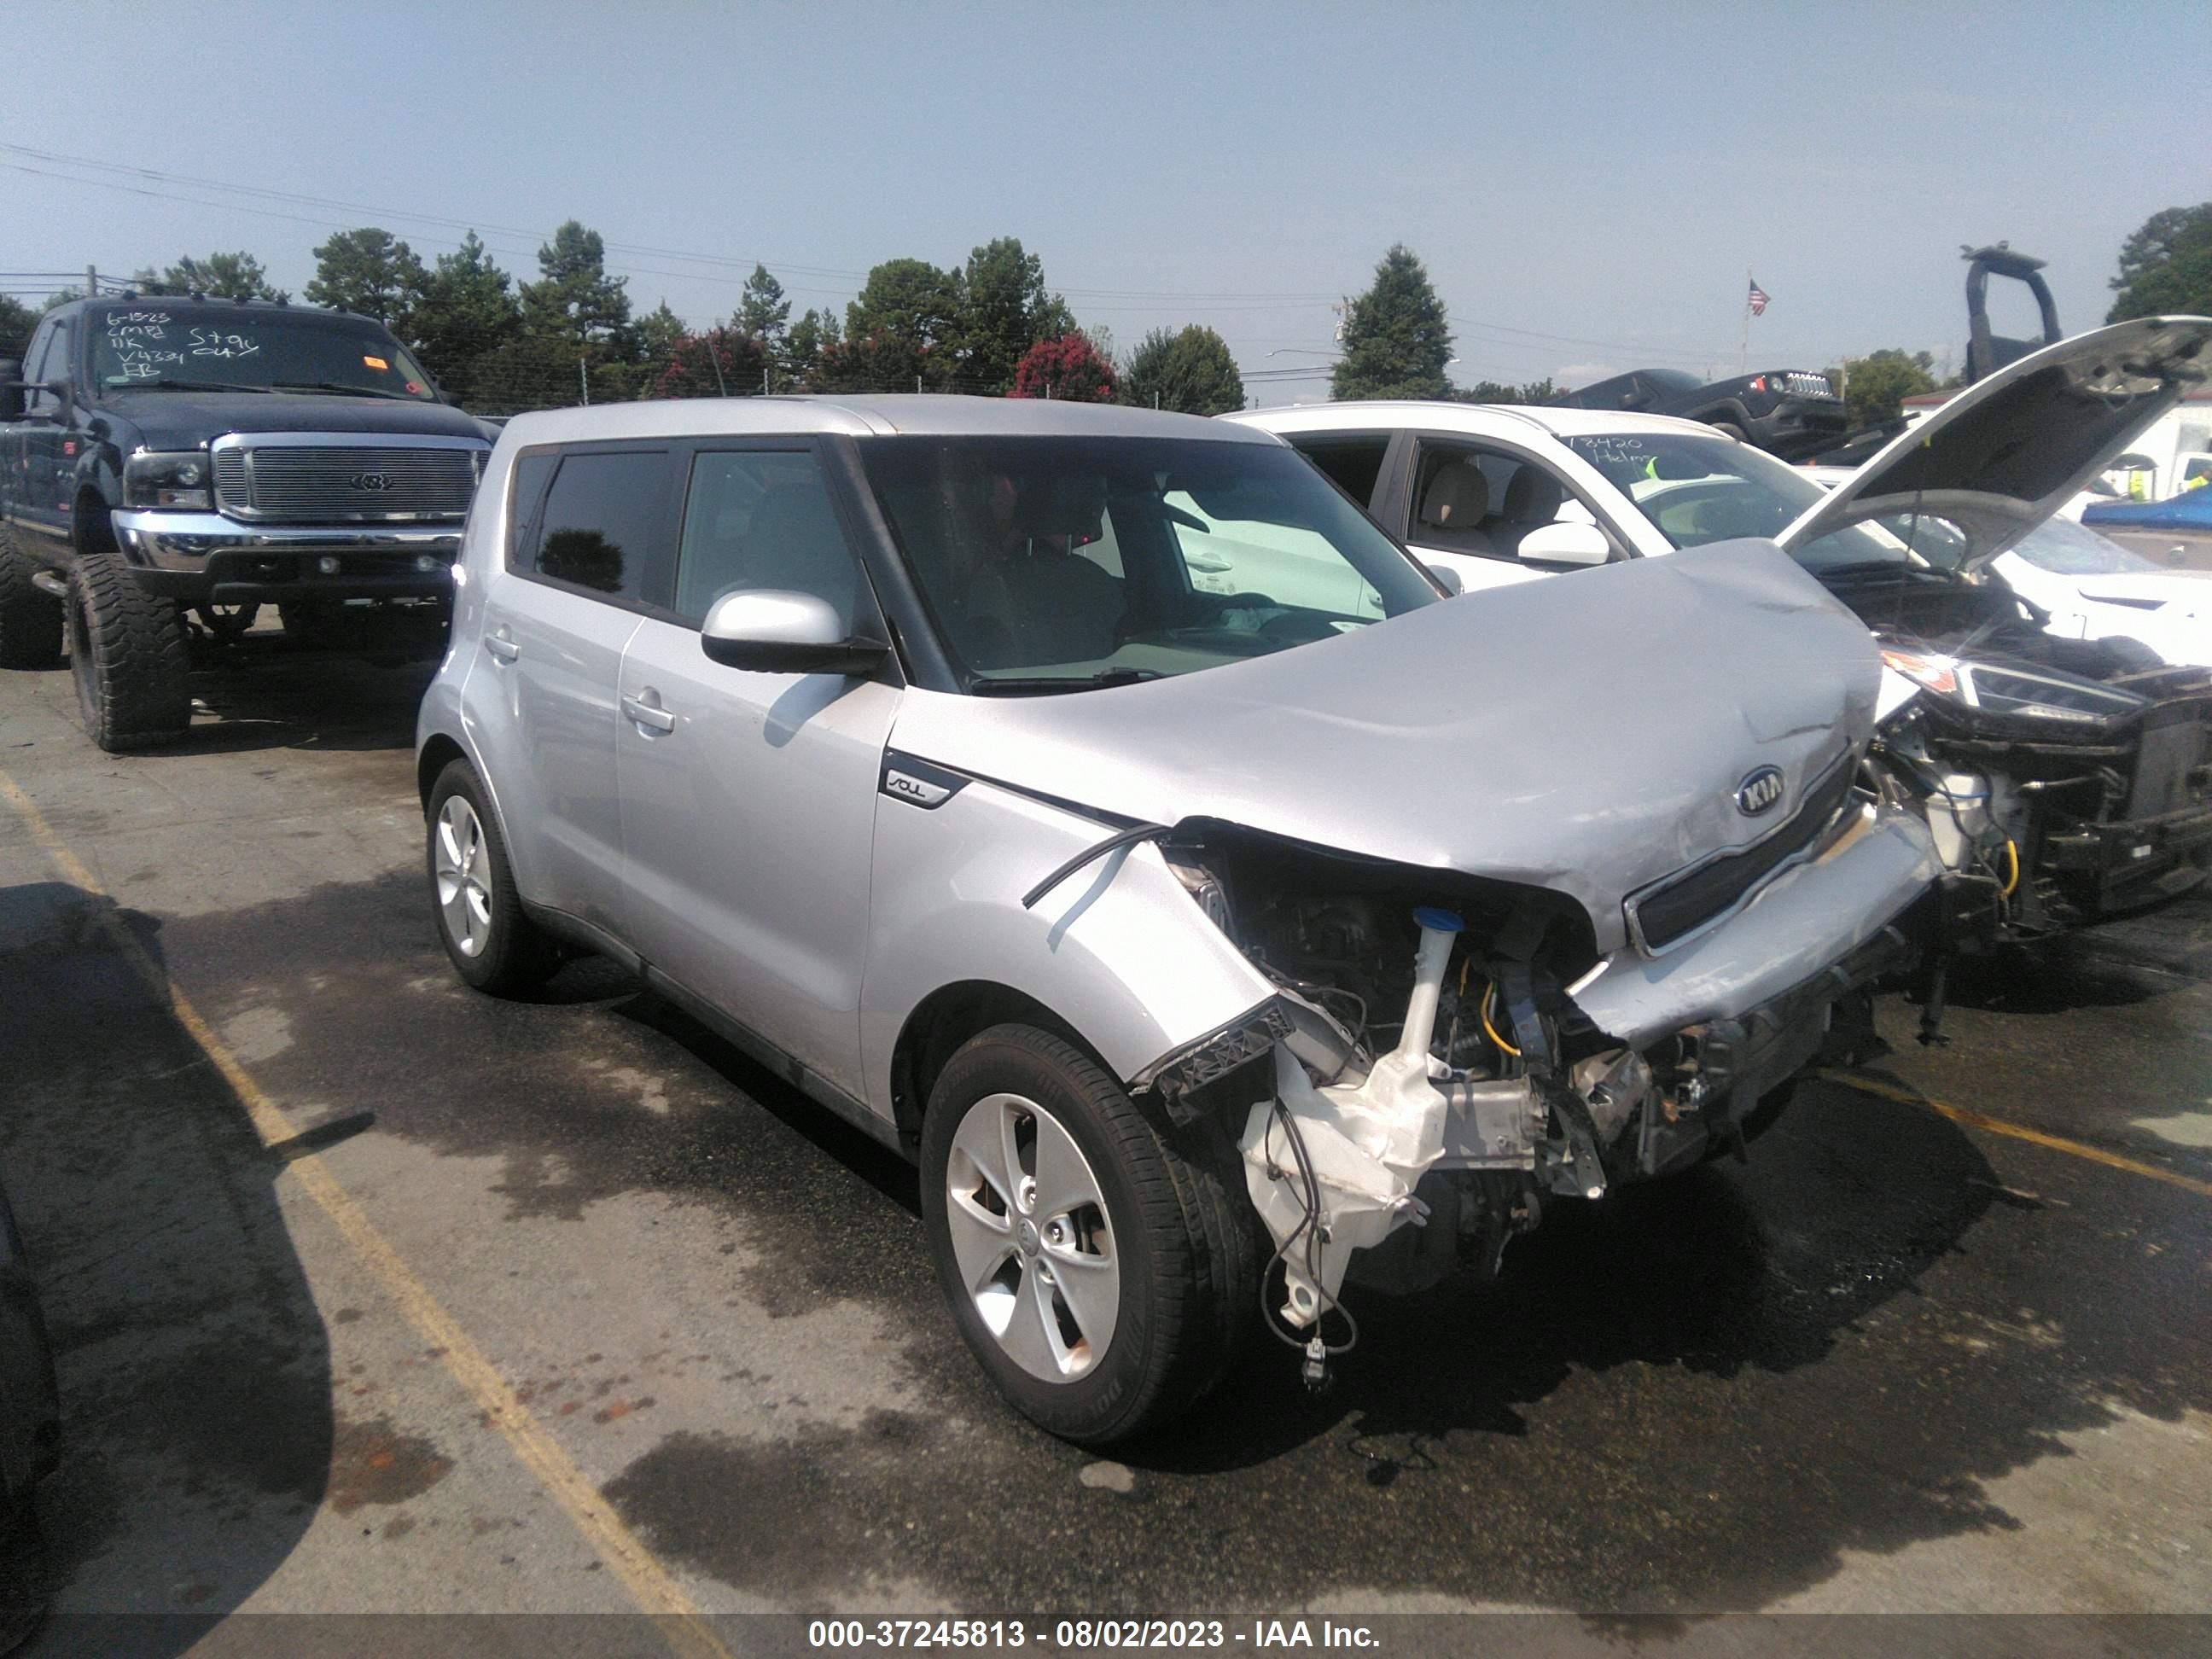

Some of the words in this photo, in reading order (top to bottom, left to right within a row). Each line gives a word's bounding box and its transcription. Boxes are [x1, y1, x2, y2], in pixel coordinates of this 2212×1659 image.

[107, 311, 171, 326] 6-15-23
[188, 327, 260, 358] Stay
[1743, 772, 1783, 811] KIA
